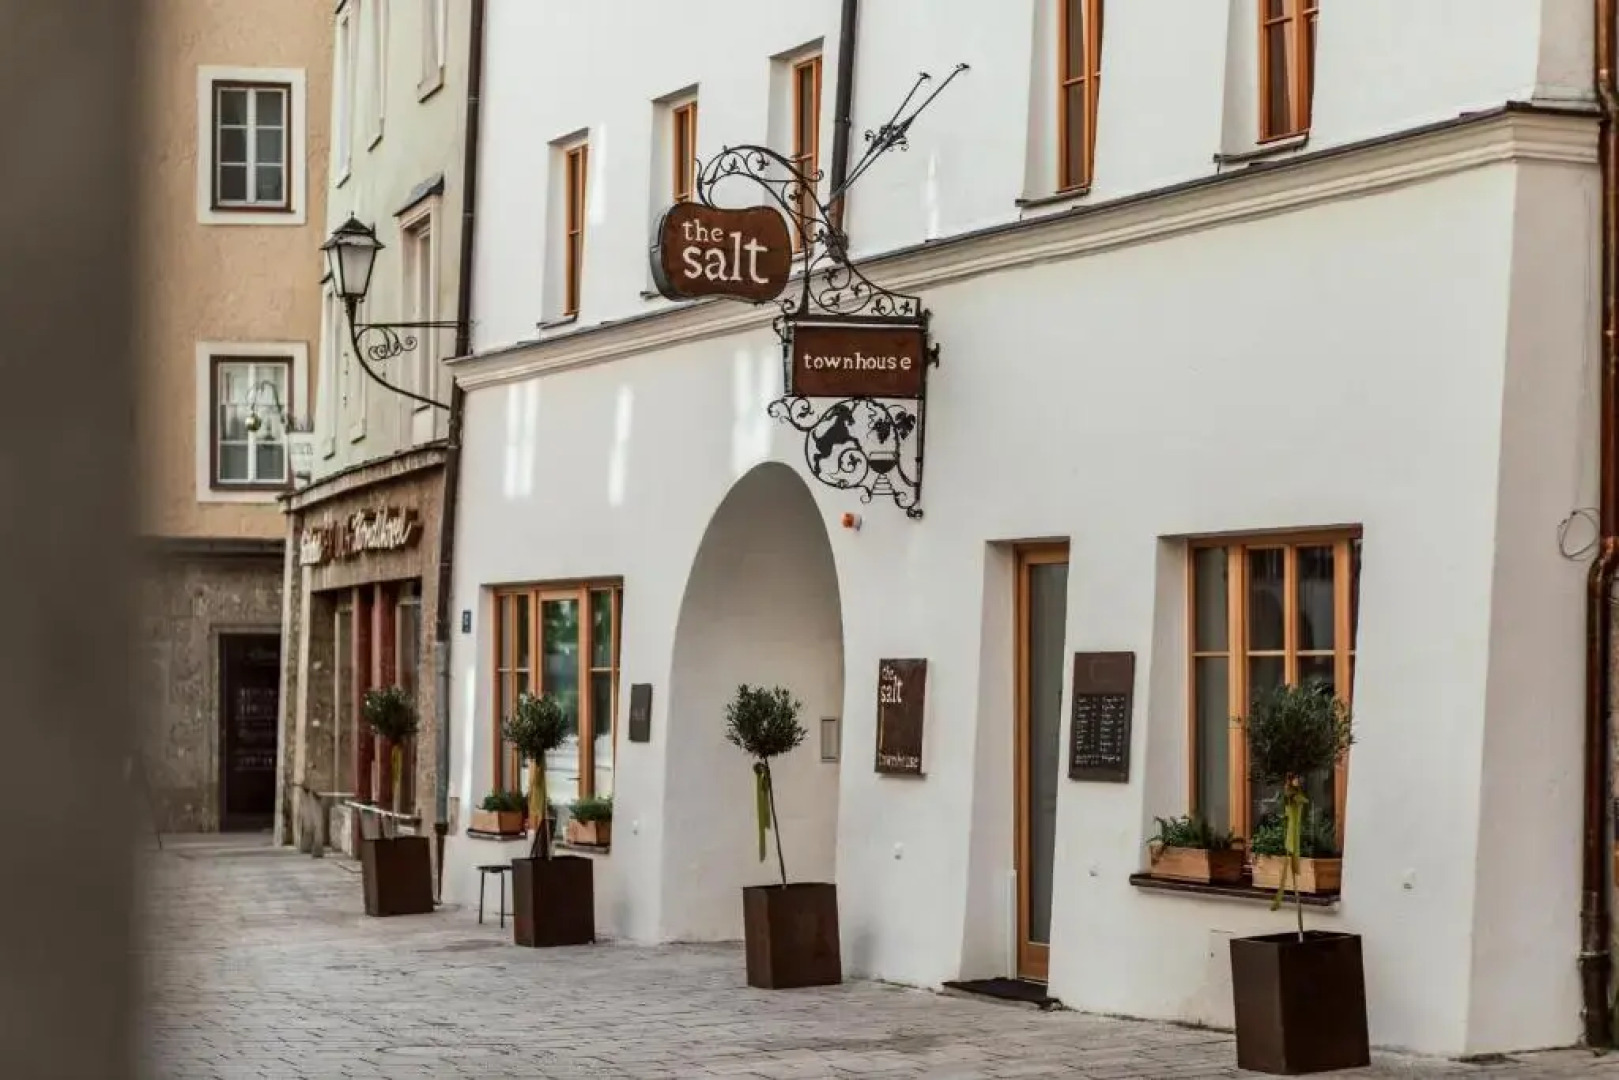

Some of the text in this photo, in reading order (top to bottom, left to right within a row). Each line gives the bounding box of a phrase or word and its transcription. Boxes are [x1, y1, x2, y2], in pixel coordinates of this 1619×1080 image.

[682, 219, 724, 243] the
[682, 231, 769, 284] salt
[803, 352, 912, 371] townhouse
[881, 674, 903, 703] salt
